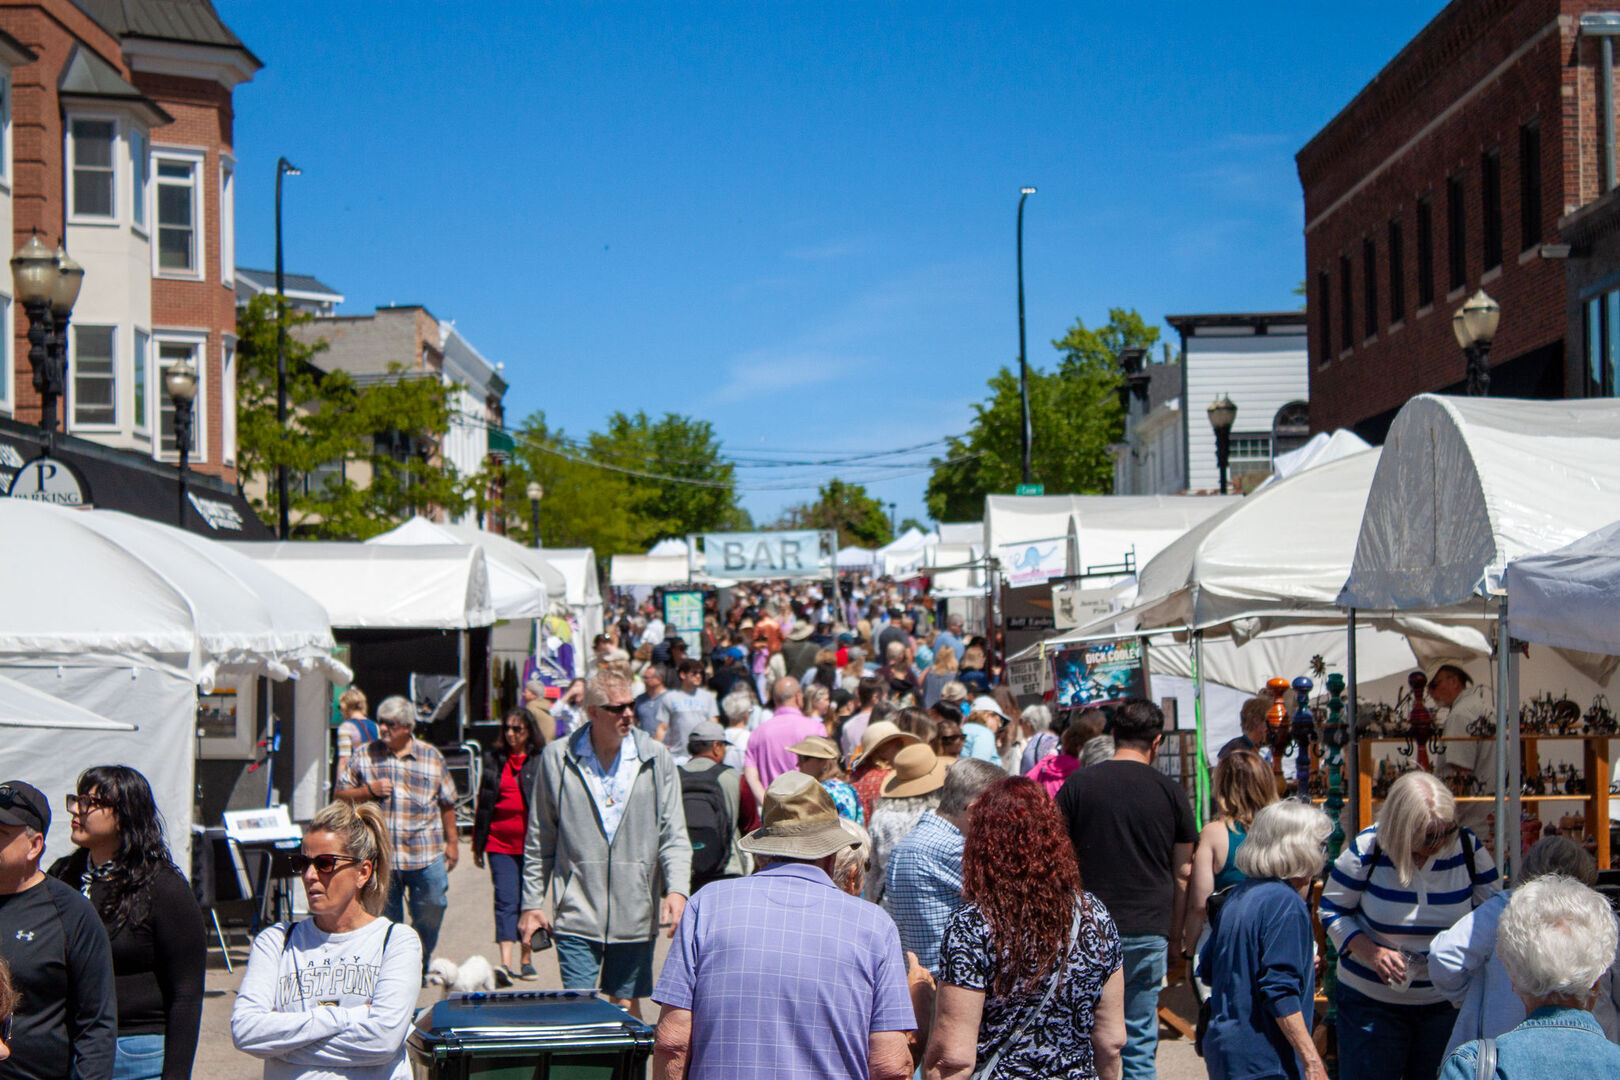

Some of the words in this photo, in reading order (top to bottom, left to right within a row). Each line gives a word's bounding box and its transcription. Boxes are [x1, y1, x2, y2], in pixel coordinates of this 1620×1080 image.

[35, 464, 57, 492] P
[724, 540, 803, 571] BAR
[1085, 651, 1107, 665] DICK
[1107, 647, 1141, 662] COOLEY
[1023, 682, 1040, 694] GIFT
